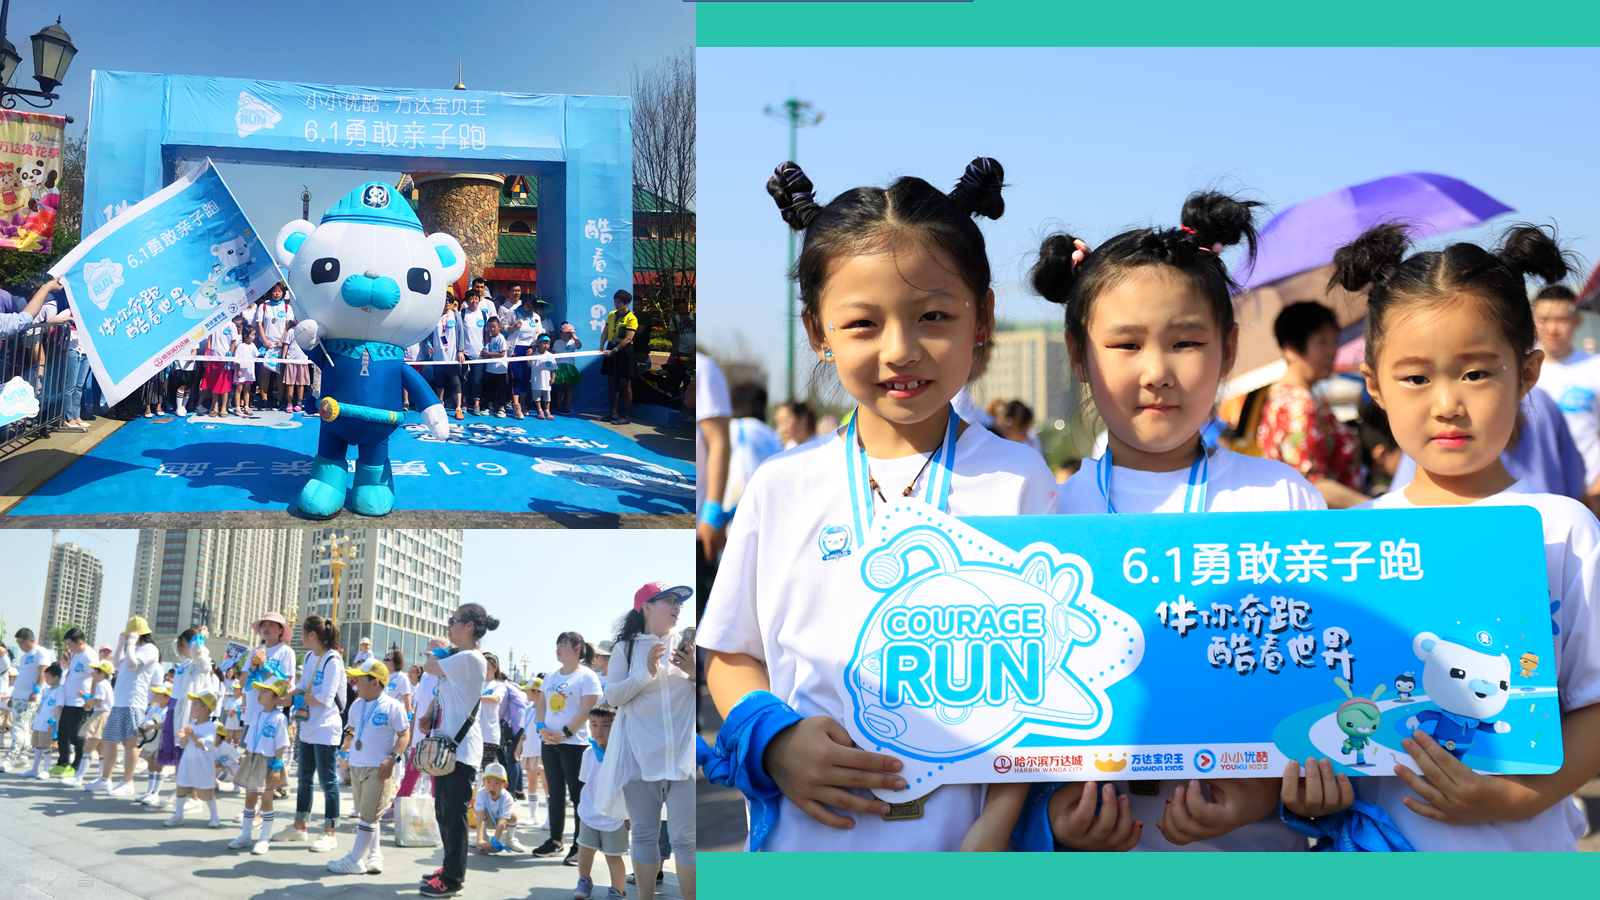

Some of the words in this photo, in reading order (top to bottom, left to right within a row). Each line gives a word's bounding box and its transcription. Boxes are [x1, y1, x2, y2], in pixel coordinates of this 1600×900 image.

[240, 114, 266, 126] RUN
[304, 118, 486, 151] 6.1勇敢亲子跑
[127, 199, 220, 269] 6.1勇敢亲子跑
[93, 274, 114, 297] RUN
[583, 217, 613, 333] 酷看世界
[3, 387, 28, 403] RUN
[154, 459, 510, 478] 6.1勇亲子跑
[1122, 538, 1424, 586] 6.1勇敢亲子跑
[885, 607, 1043, 638] COURAGE
[1154, 593, 1314, 637] 伴你奔跑
[1206, 626, 1357, 683] 酷看世界
[883, 640, 1045, 708] RUN
[1014, 754, 1084, 767] 哈尔滨万达城
[1131, 753, 1184, 765] 万达宝贝王
[1220, 750, 1269, 764] 小小优酷
[1220, 763, 1248, 771] YOUKU
[1068, 765, 1084, 773] CITY
